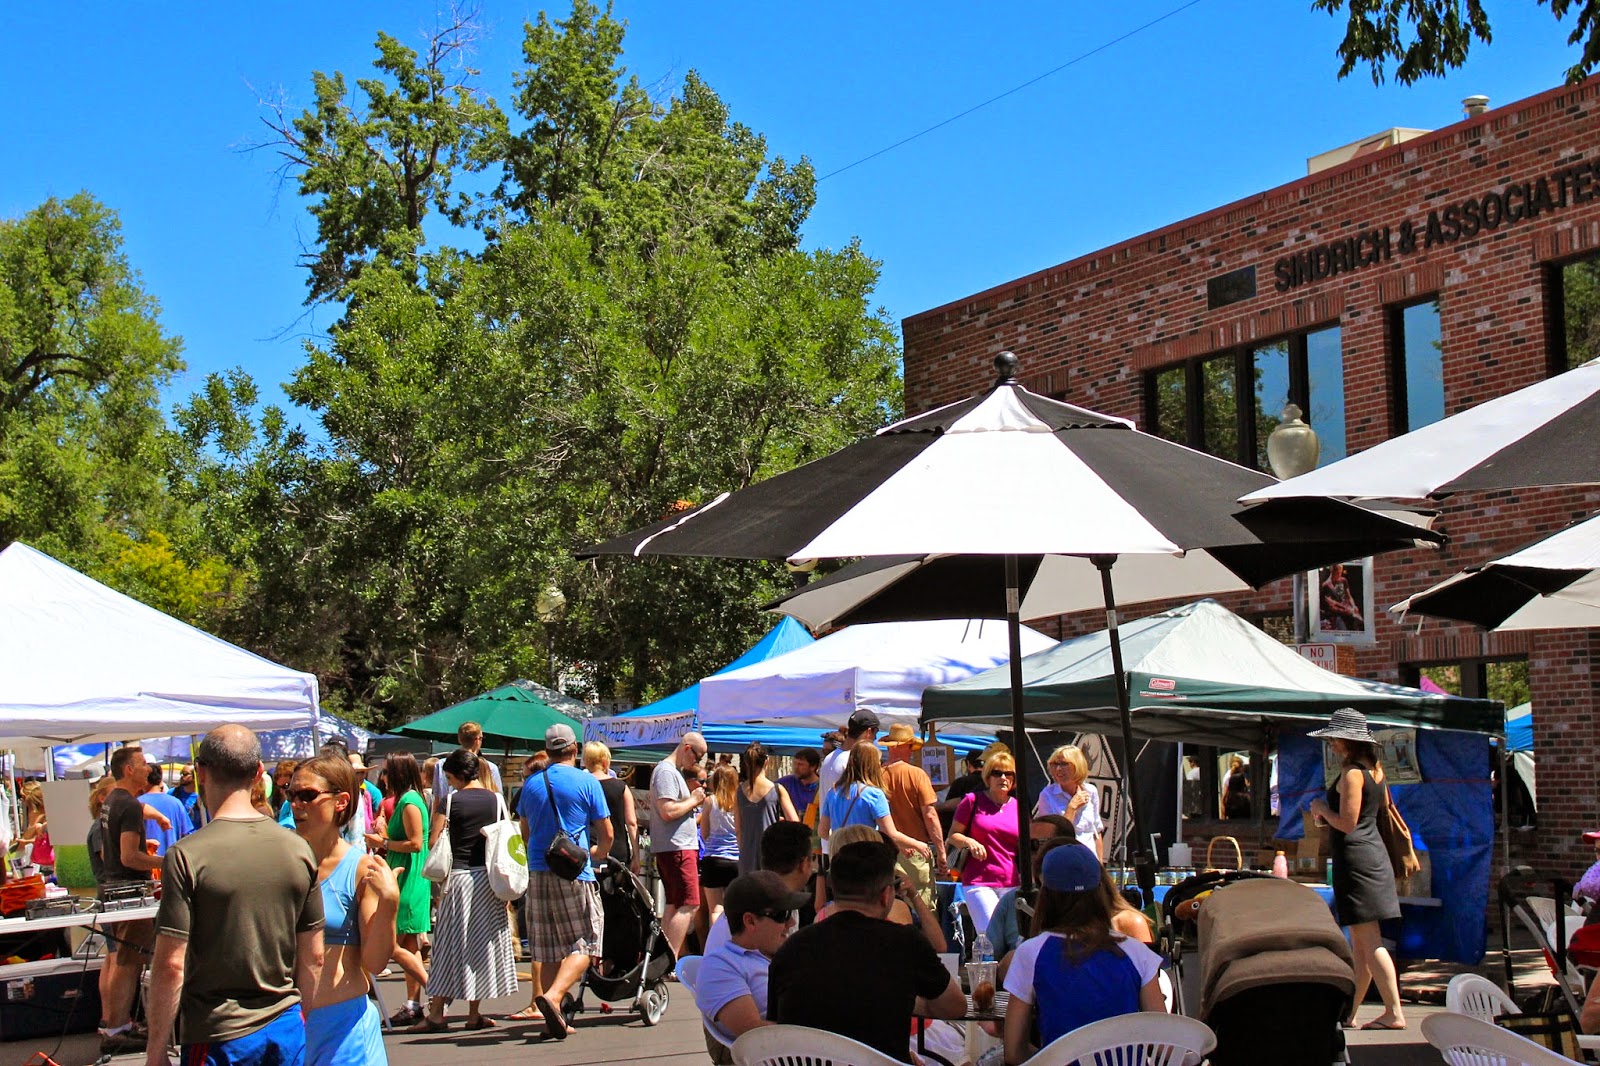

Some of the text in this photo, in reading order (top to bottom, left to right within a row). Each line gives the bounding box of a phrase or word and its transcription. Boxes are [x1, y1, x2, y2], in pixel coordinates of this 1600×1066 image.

[1274, 226, 1391, 292] SINDRICH
[1400, 219, 1416, 254] &
[1310, 647, 1324, 658] NO
